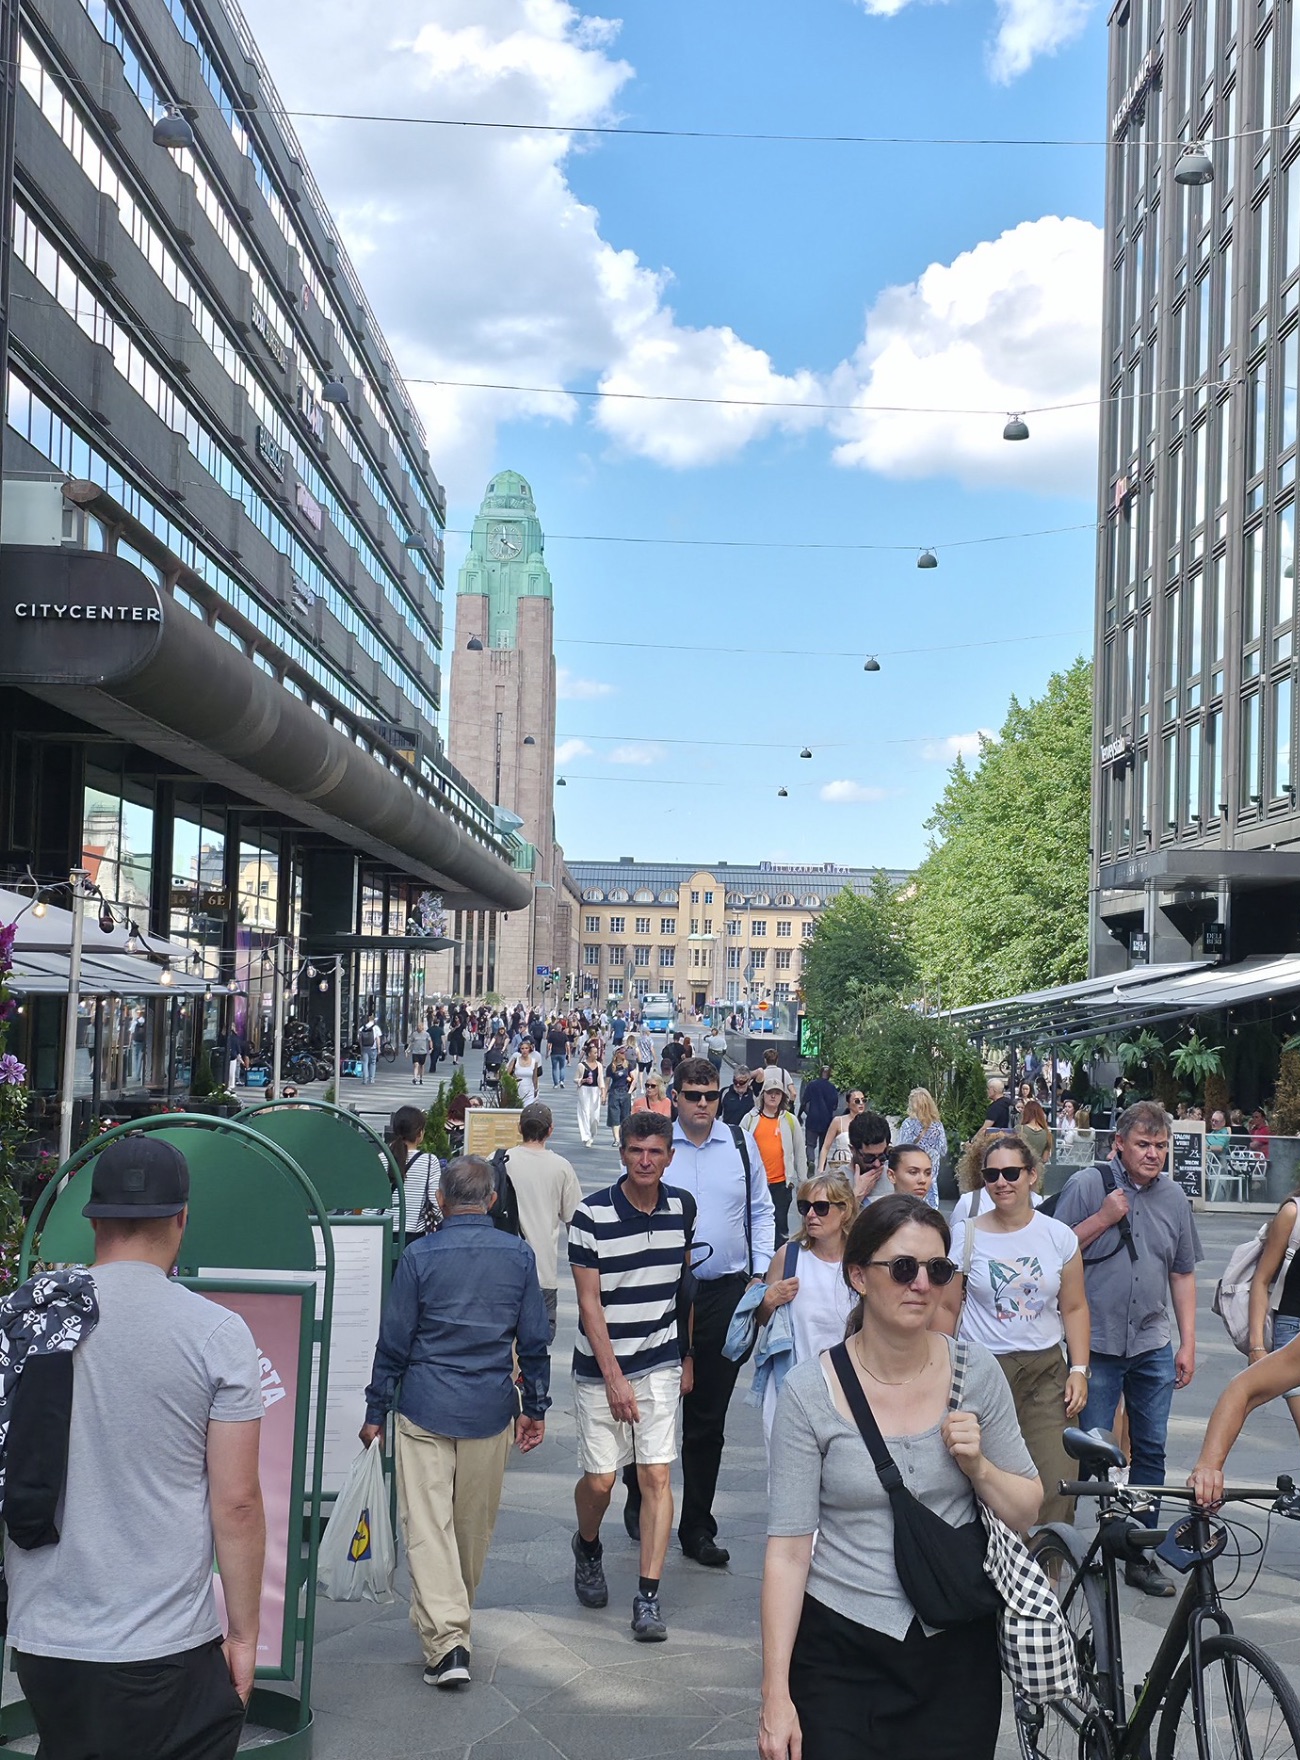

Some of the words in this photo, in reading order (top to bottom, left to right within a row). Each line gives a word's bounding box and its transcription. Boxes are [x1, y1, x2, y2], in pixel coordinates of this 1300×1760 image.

[14, 603, 160, 621] CITYCENTER
[207, 895, 226, 906] 6E
[256, 1347, 287, 1409] STA
